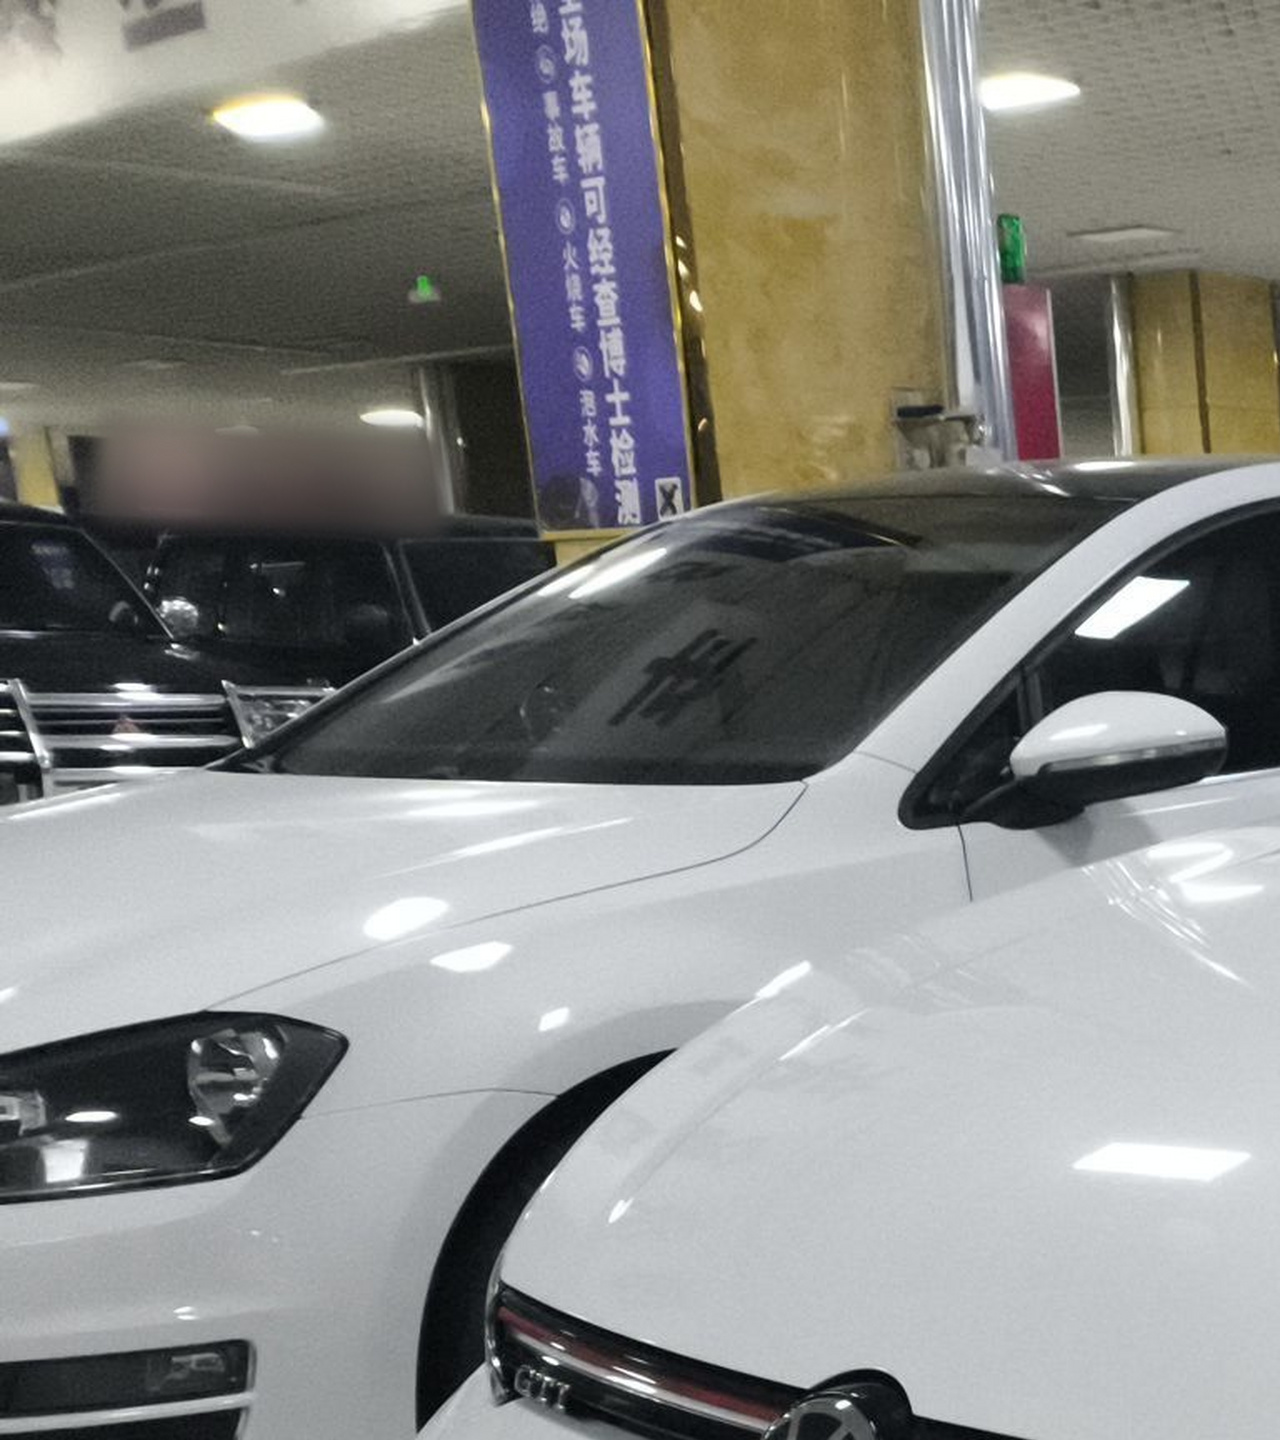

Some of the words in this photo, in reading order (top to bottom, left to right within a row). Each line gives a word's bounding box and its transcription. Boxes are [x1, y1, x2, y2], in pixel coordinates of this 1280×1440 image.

[542, 90, 569, 184] 事故车
[562, 241, 587, 333] 火烧车
[579, 389, 603, 478] 泡水车
[514, 1364, 571, 1411] GTI
